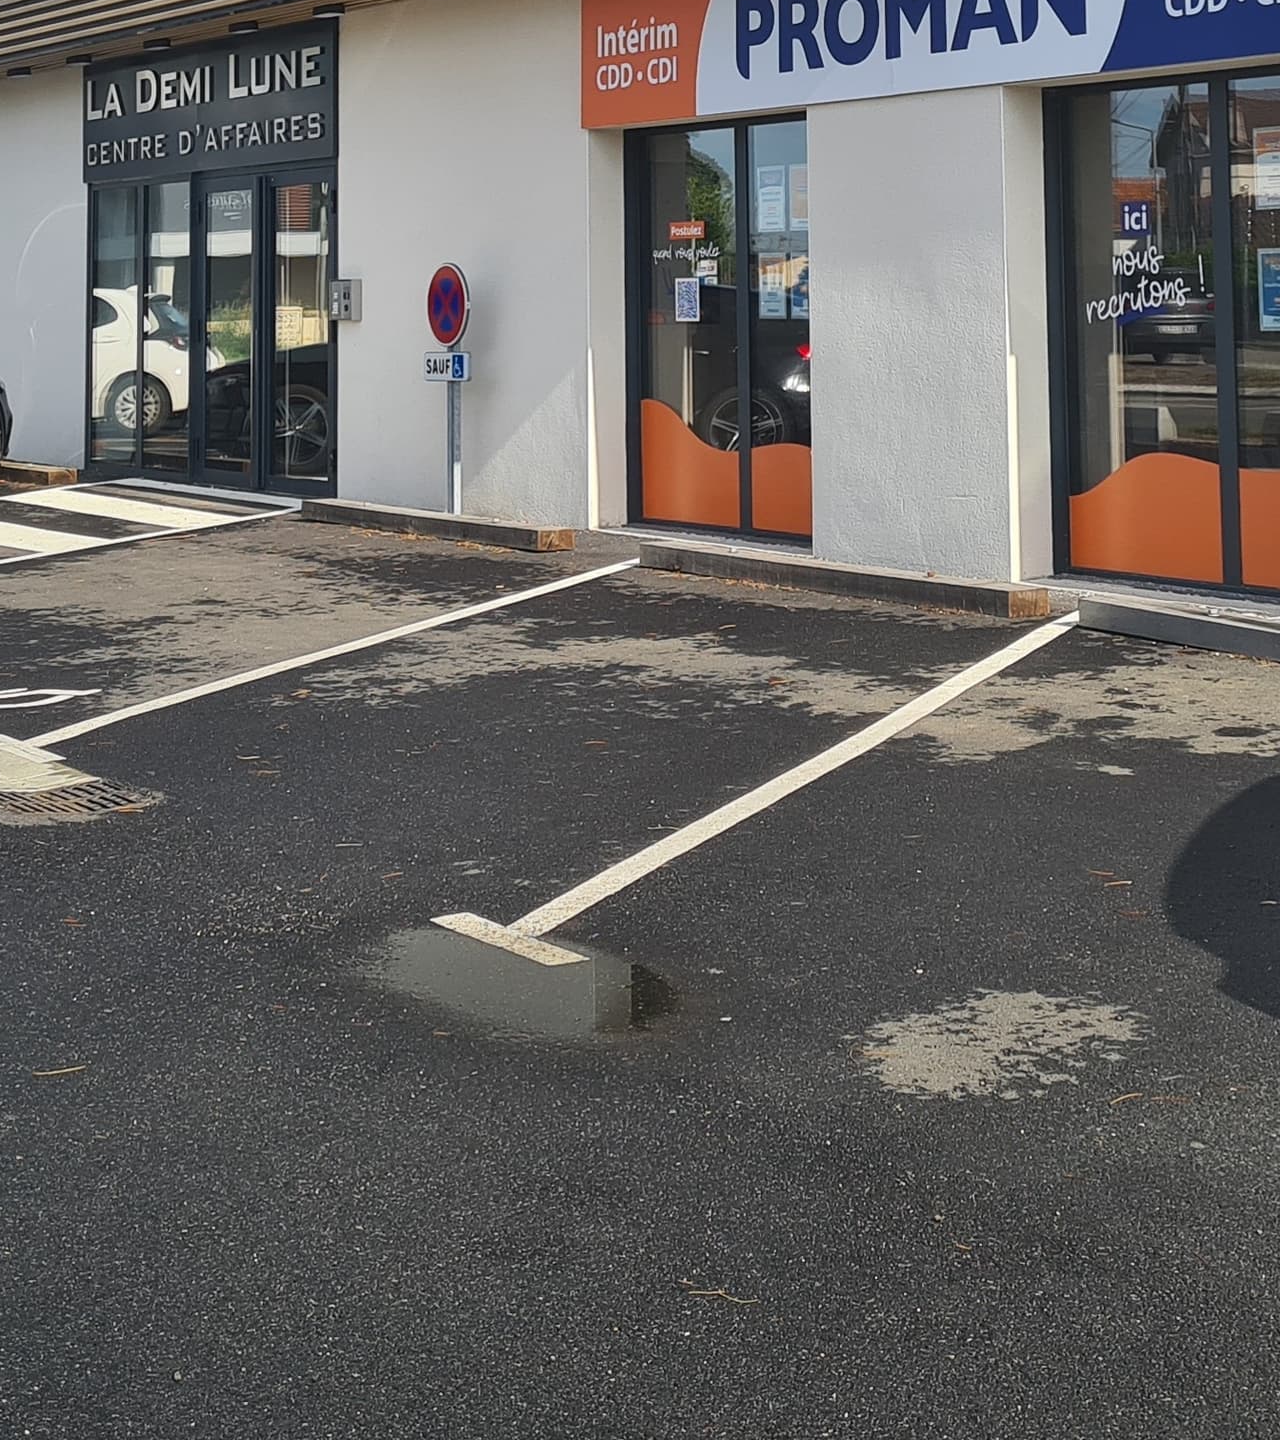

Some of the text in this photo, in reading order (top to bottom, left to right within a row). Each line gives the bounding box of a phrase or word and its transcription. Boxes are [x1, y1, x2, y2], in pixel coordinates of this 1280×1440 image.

[596, 17, 678, 58] Intérim
[87, 46, 321, 120] LA DEMI LUNE
[87, 113, 321, 166] CENTRE D'AFFAIRES
[671, 225, 702, 236] Postulez
[1124, 204, 1147, 231] ici
[1112, 246, 1164, 276] nous
[1086, 275, 1191, 324] recrutons
[426, 358, 451, 374] SAUF
